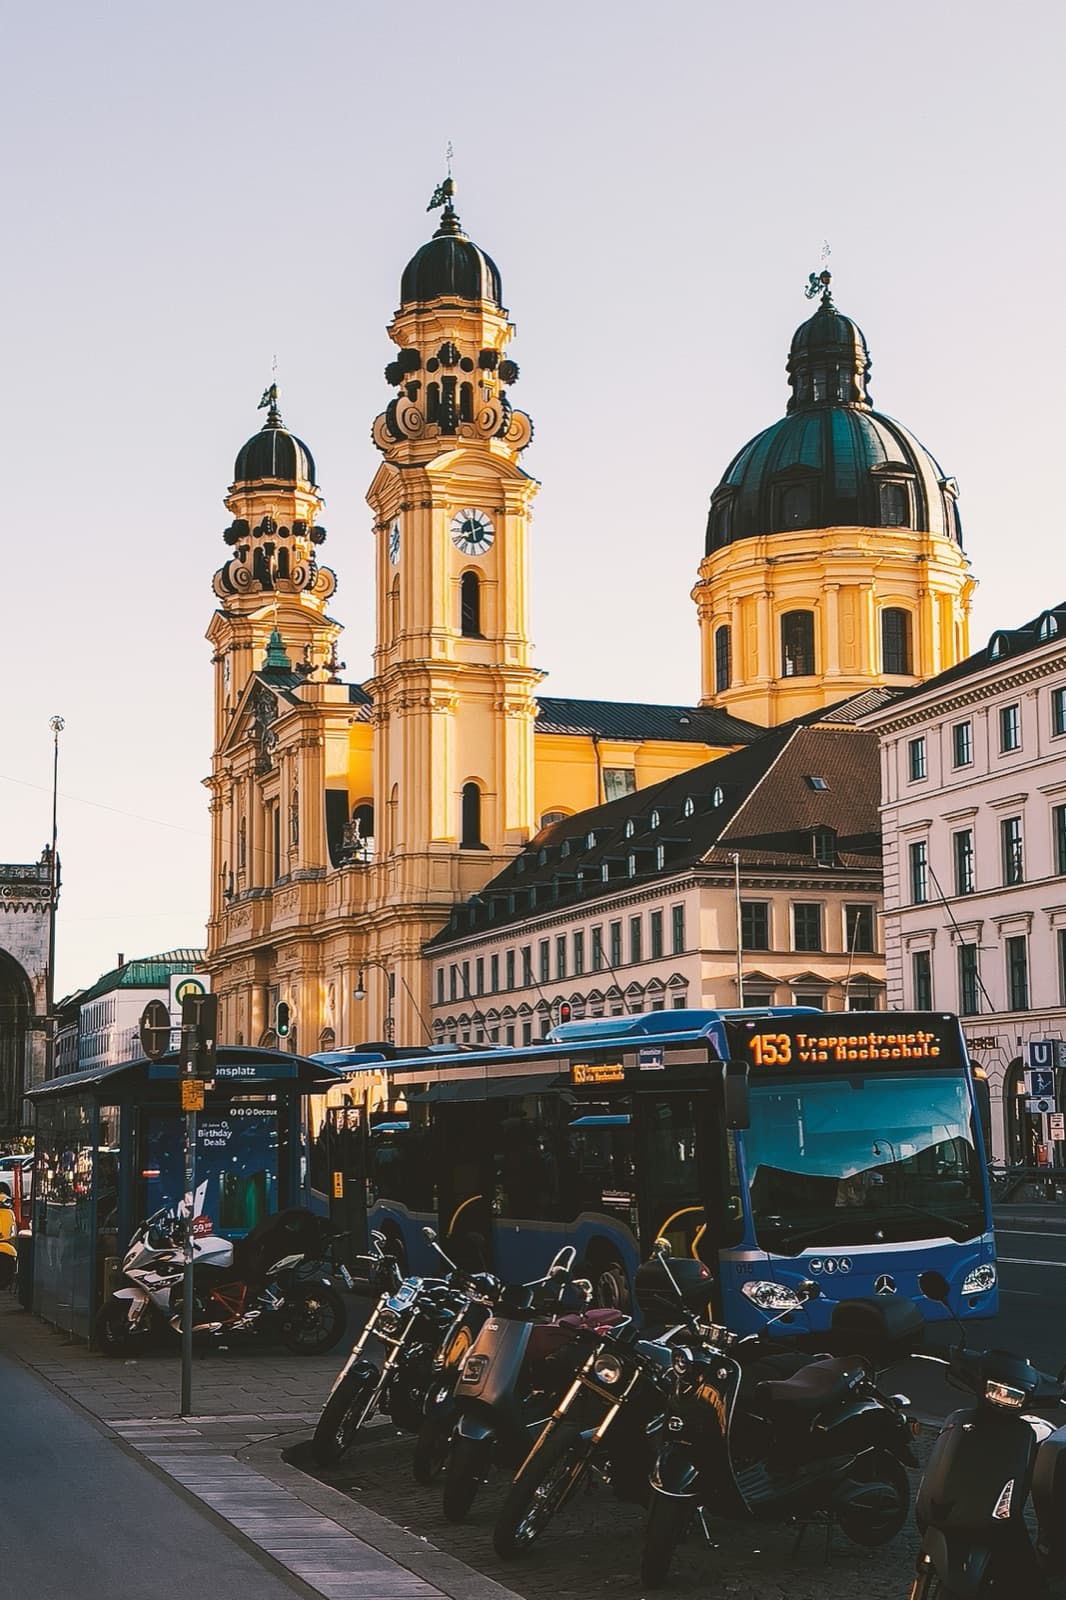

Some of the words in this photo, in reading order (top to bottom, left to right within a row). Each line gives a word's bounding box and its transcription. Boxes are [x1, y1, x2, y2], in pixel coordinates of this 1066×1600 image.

[797, 1031, 941, 1047] Trappentreustr.
[750, 1034, 791, 1065] 153
[799, 1049, 828, 1062] via
[836, 1043, 941, 1060] Hochschule
[1034, 1045, 1048, 1063] U
[198, 1129, 232, 1139] Birthday
[203, 1138, 226, 1147] Deals
